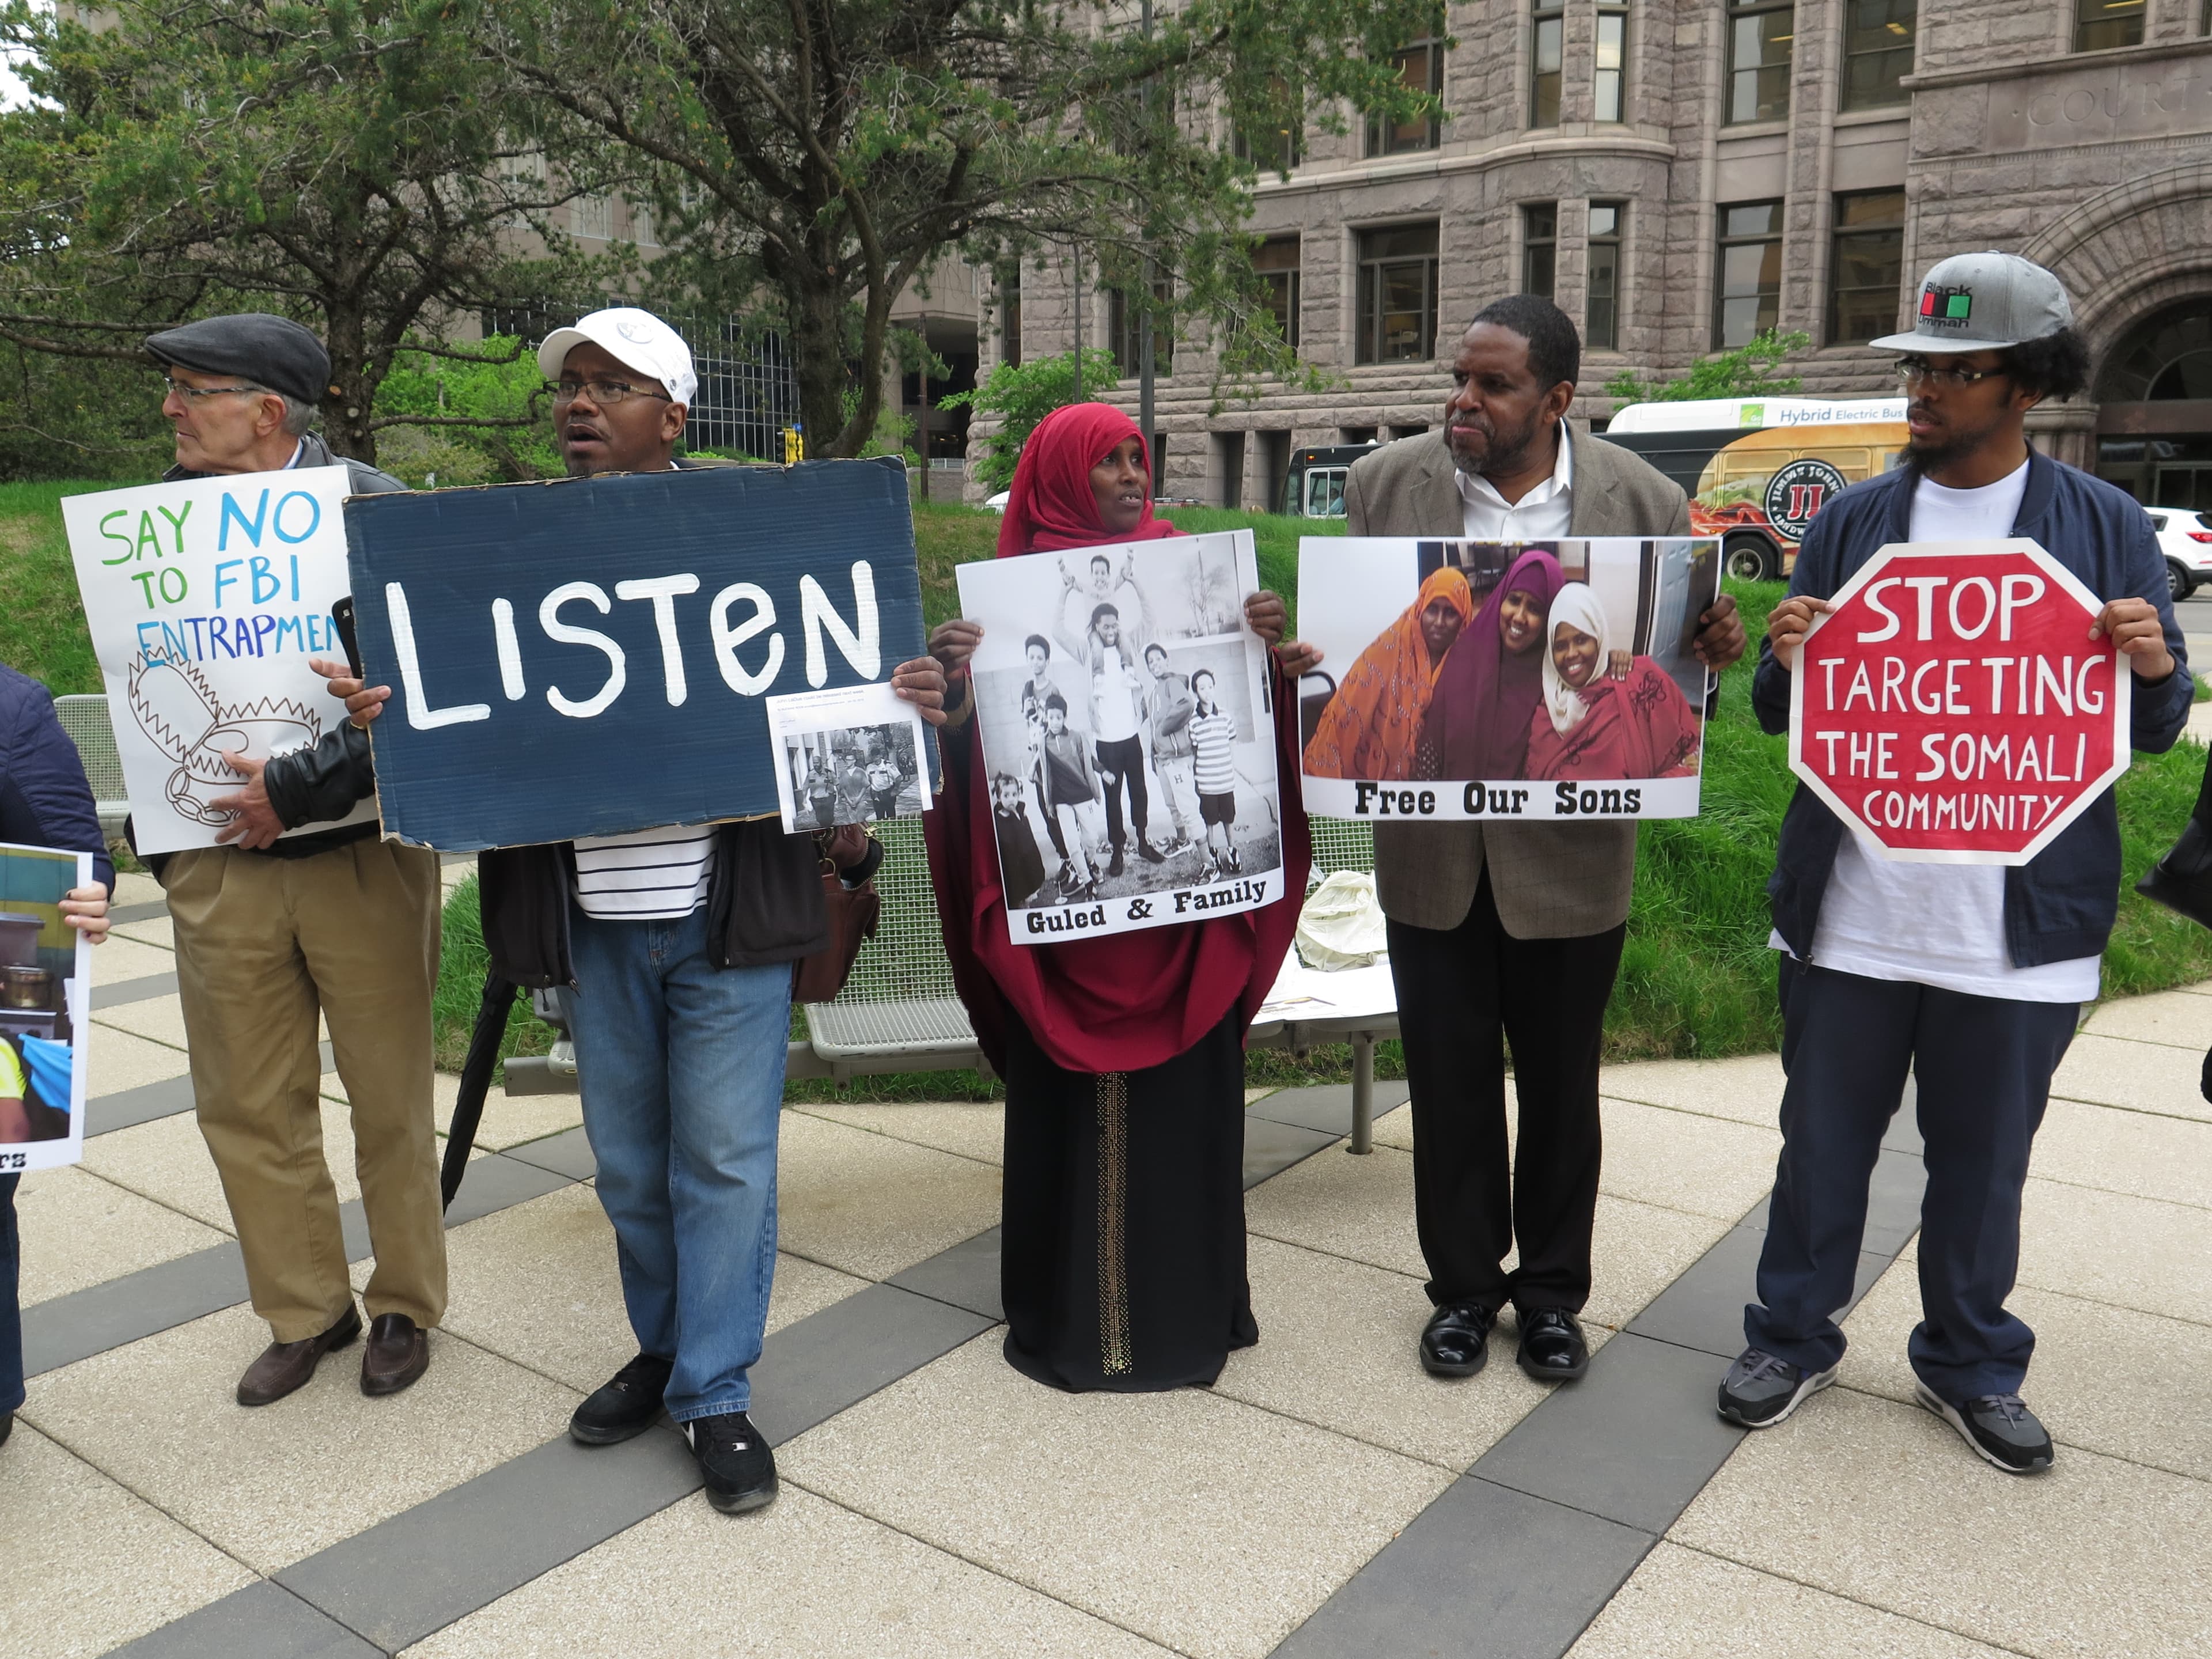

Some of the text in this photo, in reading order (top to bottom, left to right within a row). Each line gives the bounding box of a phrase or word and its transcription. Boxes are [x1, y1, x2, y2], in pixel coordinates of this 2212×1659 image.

[2027, 75, 2201, 126] COURT
[1925, 282, 1972, 295] Black
[1918, 315, 1969, 328] Ummah
[1780, 407, 1904, 426] Hybrid Electric Bus
[1772, 466, 1841, 501] JIMMY JOHN'
[100, 488, 320, 565] SAY NO
[131, 555, 300, 609] TO FBI
[1857, 574, 2046, 643] STOP
[1817, 654, 2107, 717] TARGETING
[1816, 731, 2086, 782] THE SOMALI
[1355, 780, 1641, 815] Free Our Sons
[1863, 790, 2065, 831] COMMUNITY
[1026, 880, 1267, 934] Guled & Family
